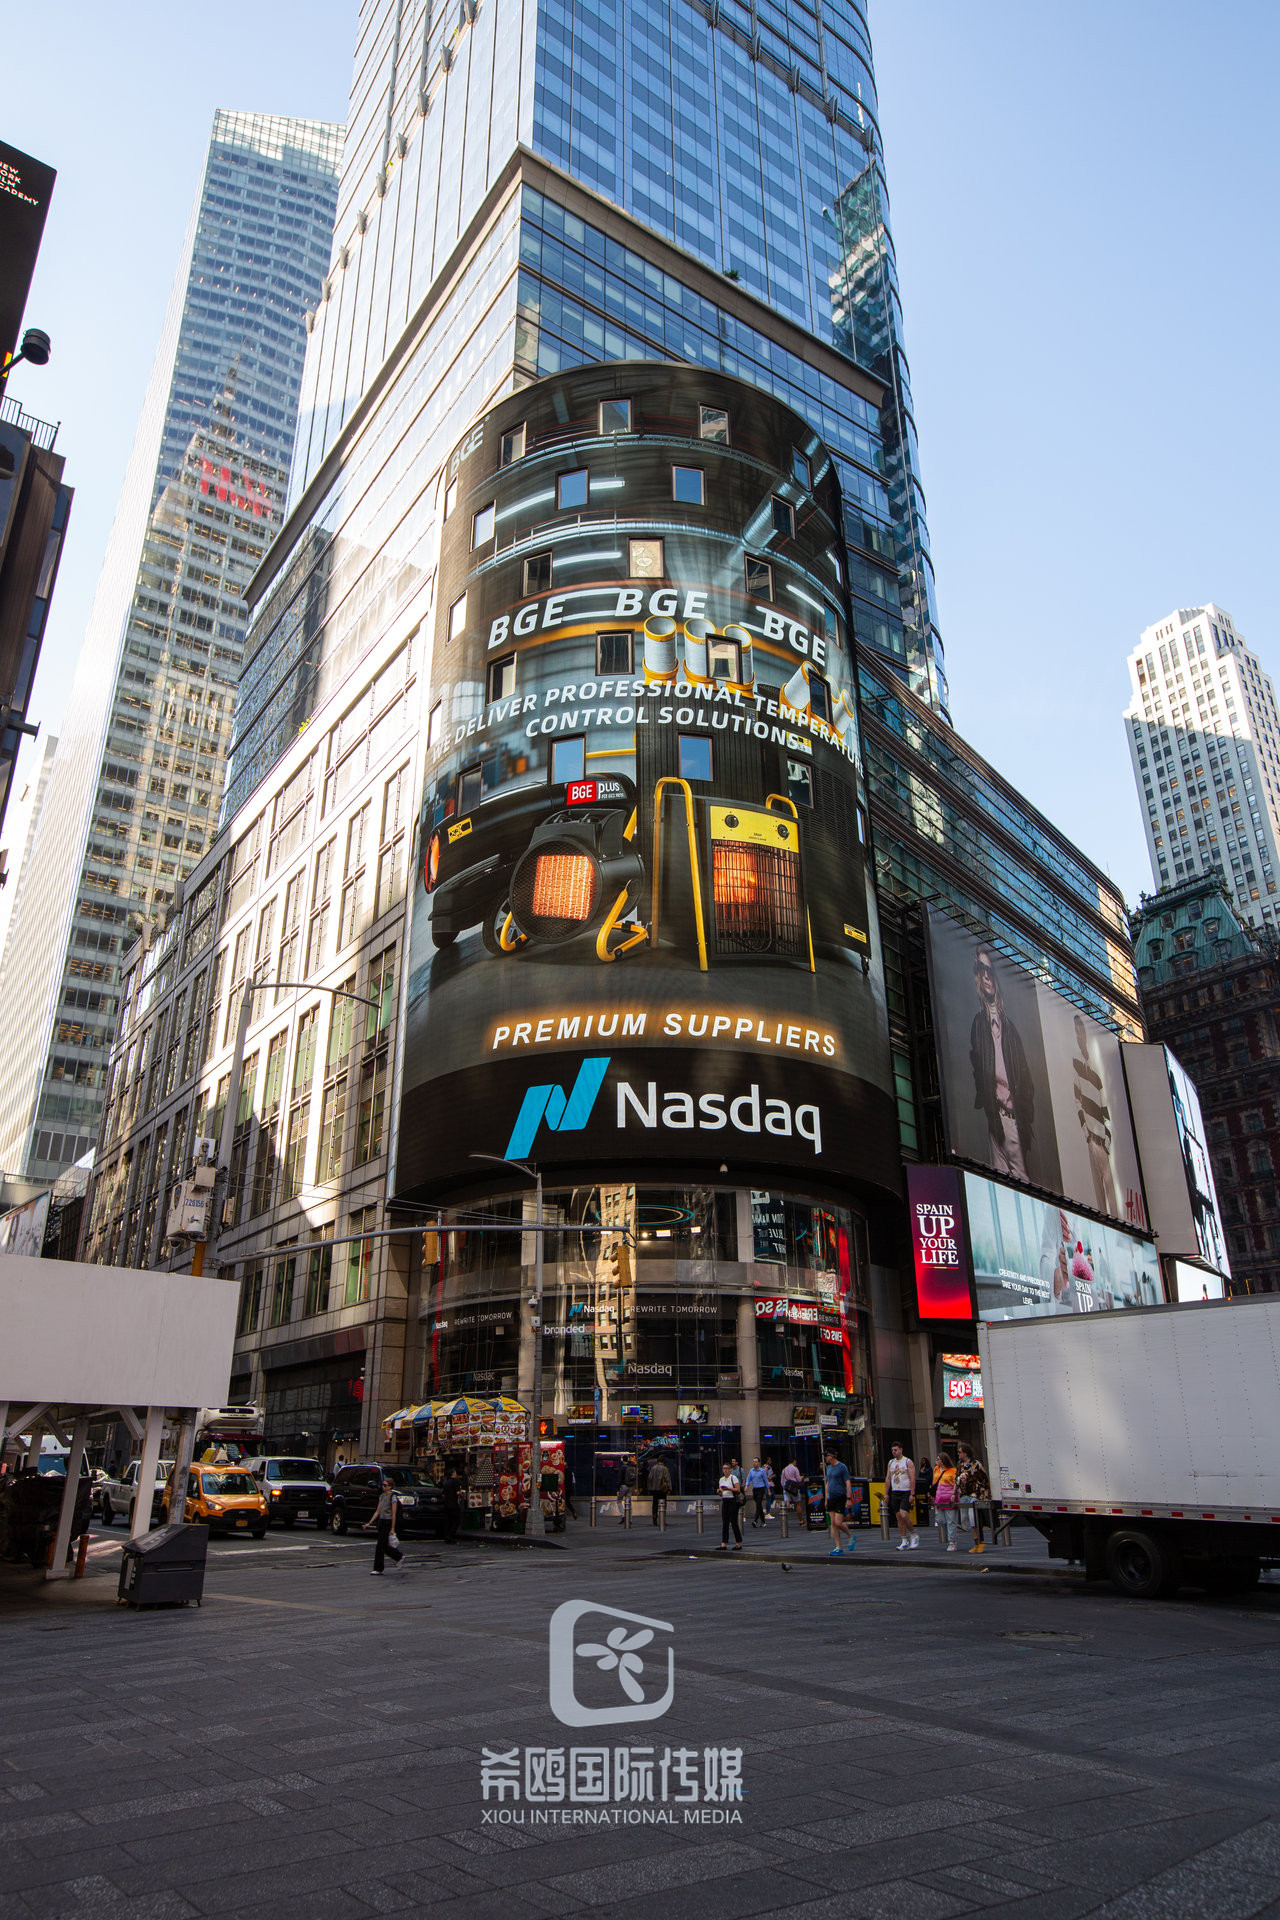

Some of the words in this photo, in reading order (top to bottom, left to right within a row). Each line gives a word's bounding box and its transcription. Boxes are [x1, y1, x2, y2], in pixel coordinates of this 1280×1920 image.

[0, 169, 21, 184] ORK
[0, 182, 39, 206] CADEMY
[614, 588, 708, 620] BGE
[488, 594, 567, 650] BGE
[763, 613, 826, 667] BGE
[433, 733, 452, 764] WE
[454, 693, 537, 746] DELIVER
[545, 680, 753, 712] PROFESSIONAL
[754, 696, 865, 779] TEMPERATURE
[525, 706, 649, 738] CONTROL
[658, 706, 799, 750] SOLUTIONS
[571, 784, 593, 800] BGE
[492, 1013, 647, 1049] PREMIUM
[663, 1013, 836, 1056] SUPPLIERS
[617, 1081, 823, 1155] Nasdaq
[916, 1203, 953, 1216] SPAIN
[917, 1215, 955, 1238] UP
[919, 1237, 957, 1250] YOUR
[920, 1249, 959, 1265] LIFE
[1075, 1280, 1092, 1295] SPAIN
[583, 1304, 615, 1315] Nasdaq
[630, 1305, 667, 1313] REWRITE
[670, 1305, 718, 1314] TOMORROW
[1076, 1292, 1094, 1312] UP
[477, 1311, 512, 1323] TOMORROW
[627, 1362, 672, 1377] Nasdaq
